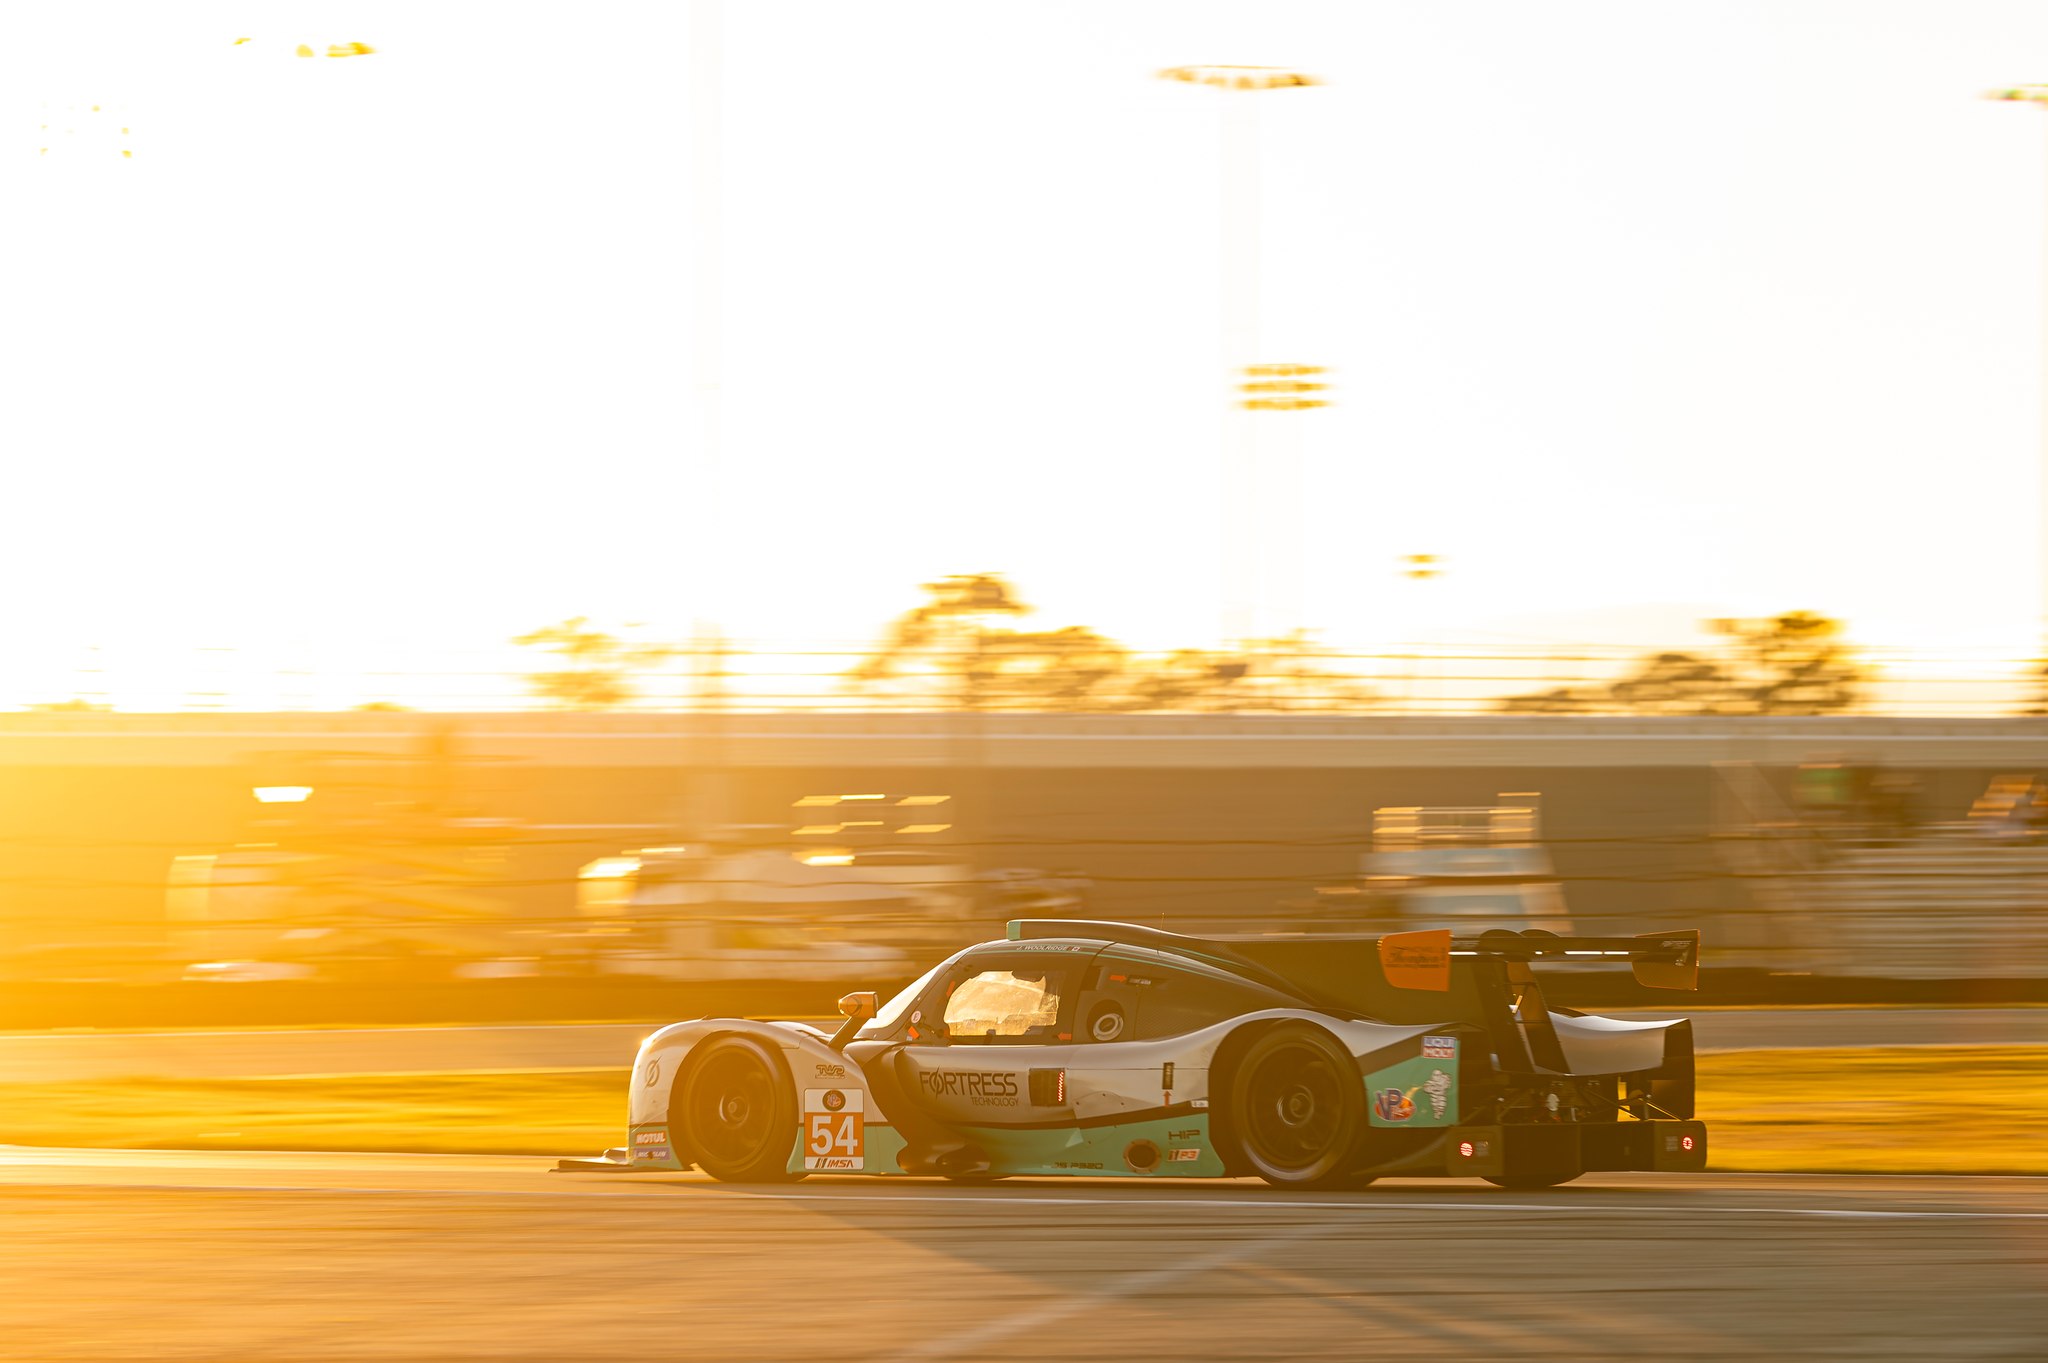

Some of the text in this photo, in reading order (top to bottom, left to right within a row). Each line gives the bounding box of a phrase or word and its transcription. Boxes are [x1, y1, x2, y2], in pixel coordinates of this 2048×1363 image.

[971, 1096, 1019, 1107] TECHNOLOGY
[636, 1132, 666, 1144] MOTUL
[811, 1115, 859, 1156] 54
